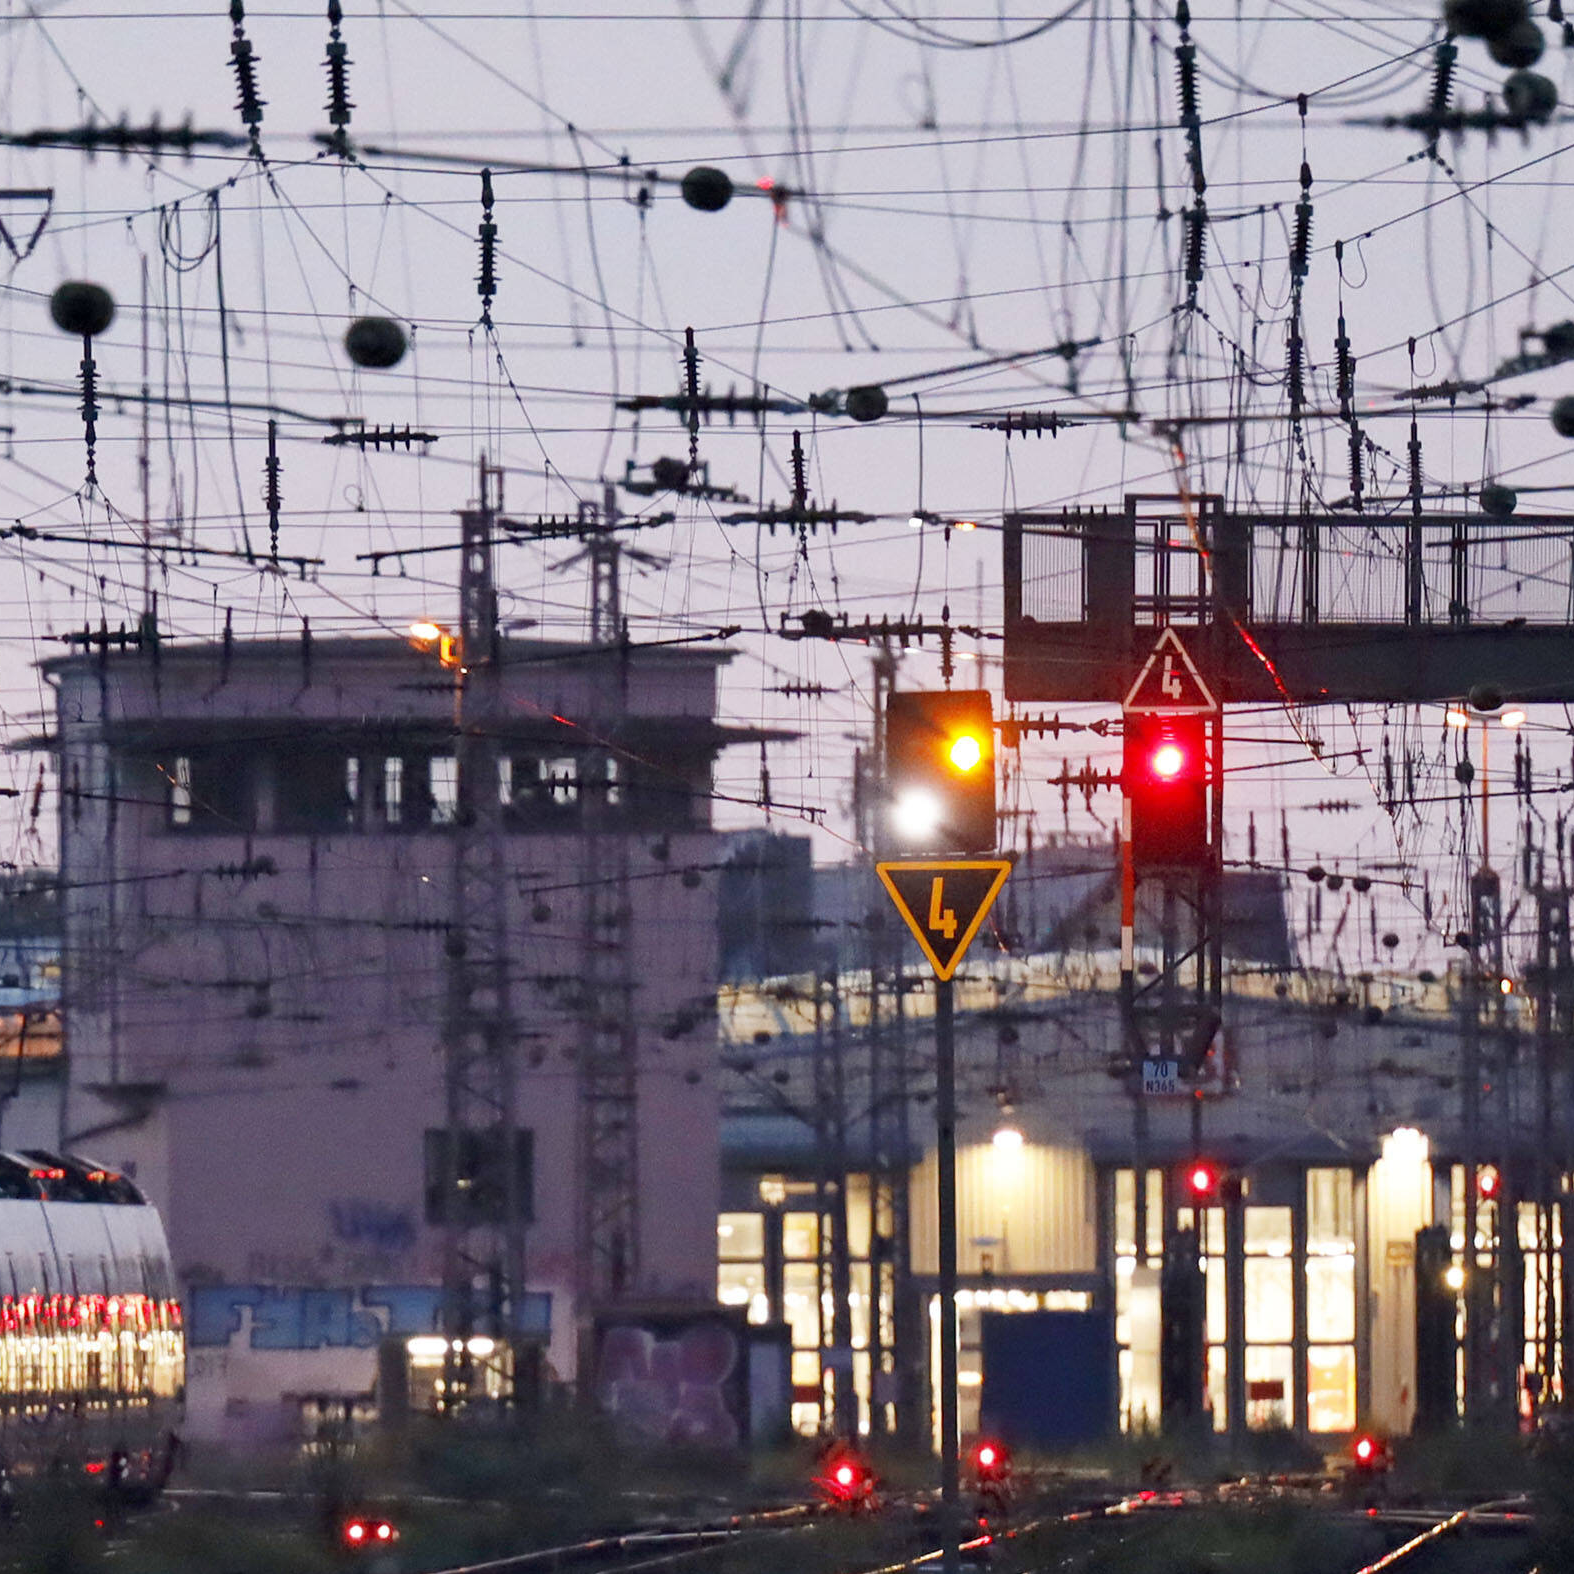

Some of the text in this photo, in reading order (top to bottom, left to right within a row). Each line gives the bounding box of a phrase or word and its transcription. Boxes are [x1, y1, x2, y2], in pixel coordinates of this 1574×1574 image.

[1162, 655, 1183, 700] 4
[928, 876, 958, 939] 4
[1153, 1062, 1169, 1078] 70
